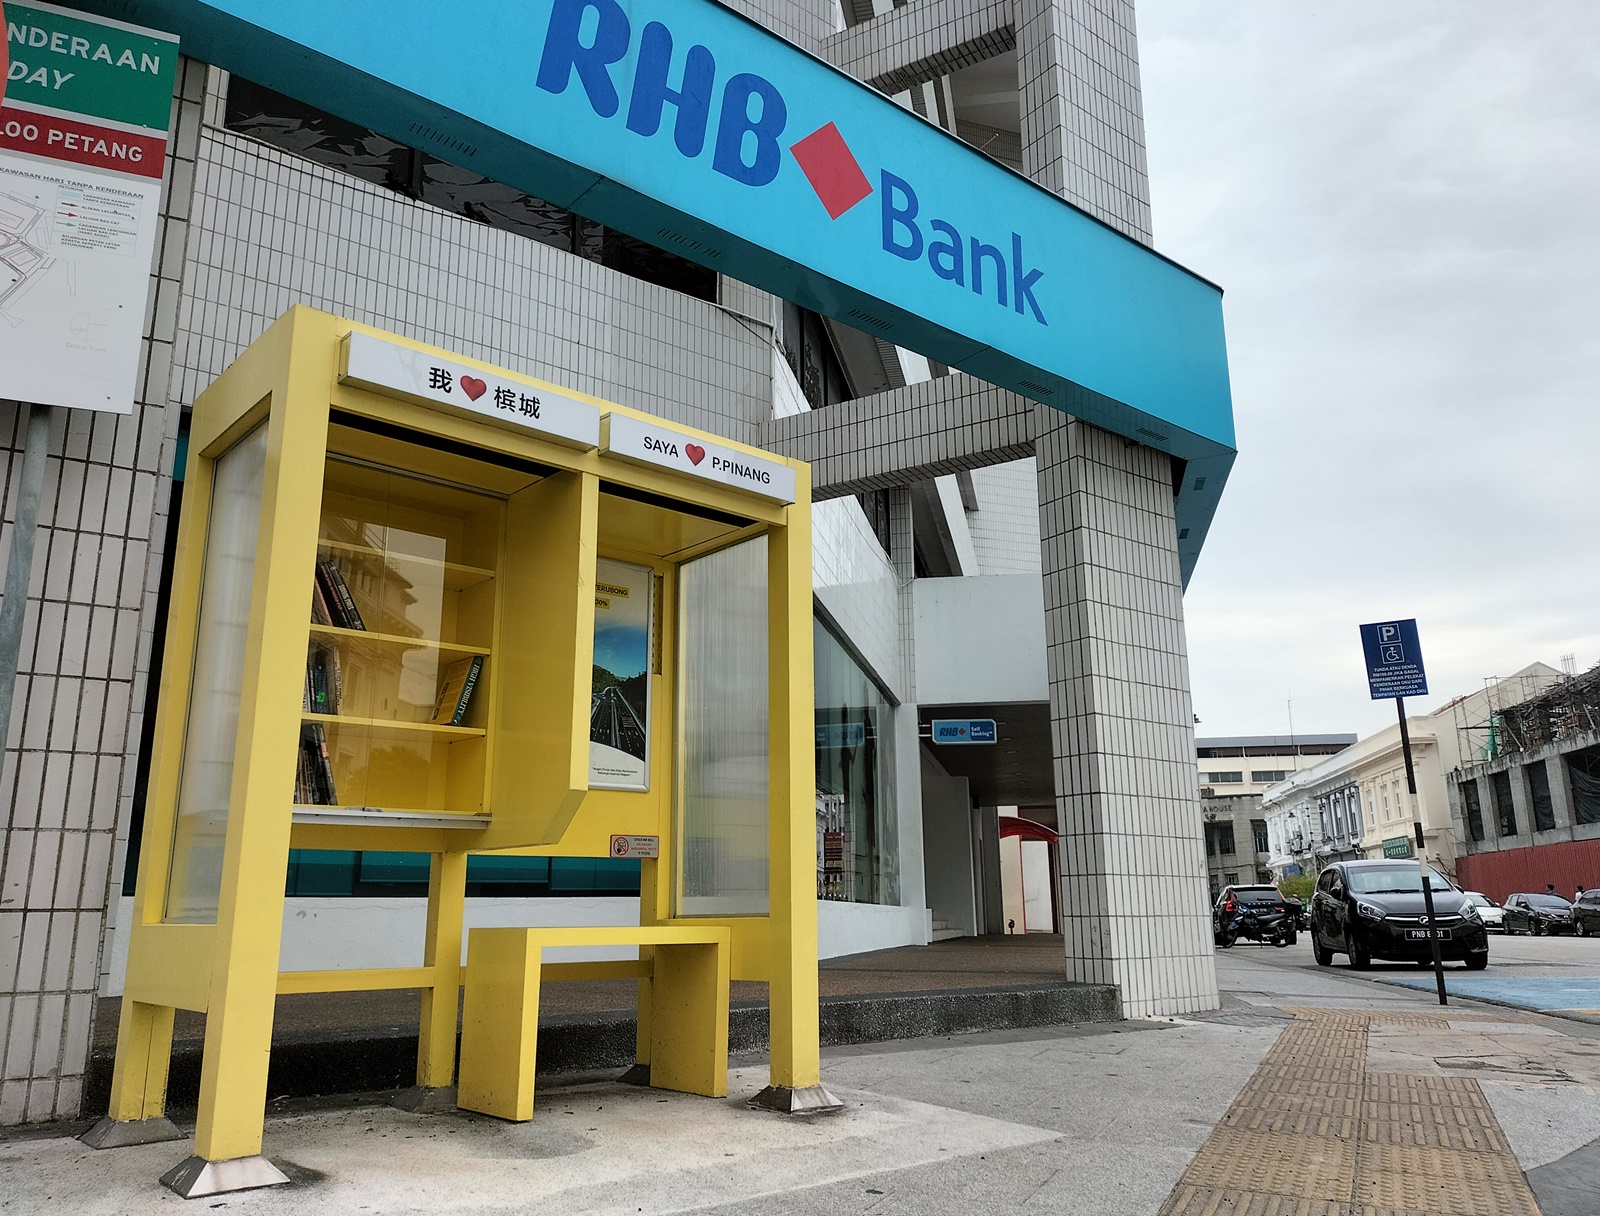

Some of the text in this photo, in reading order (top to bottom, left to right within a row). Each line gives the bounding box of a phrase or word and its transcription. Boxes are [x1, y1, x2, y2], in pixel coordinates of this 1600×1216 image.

[7, 60, 76, 90] DAY
[535, 0, 788, 188] RHB
[47, 129, 143, 162] PETANG
[43, 175, 64, 185] HARI
[66, 180, 94, 190] TANPA
[95, 185, 144, 199] KENDERAAN
[880, 168, 1049, 328] Bank
[428, 366, 541, 420] 我 槟城
[643, 436, 771, 485] SAYA P.PINANG
[1381, 626, 1395, 642] P
[469, 664, 480, 682] HIGH
[457, 682, 475, 716] VISIBILITY
[939, 727, 959, 737] RHB
[1411, 930, 1426, 938] PNB
